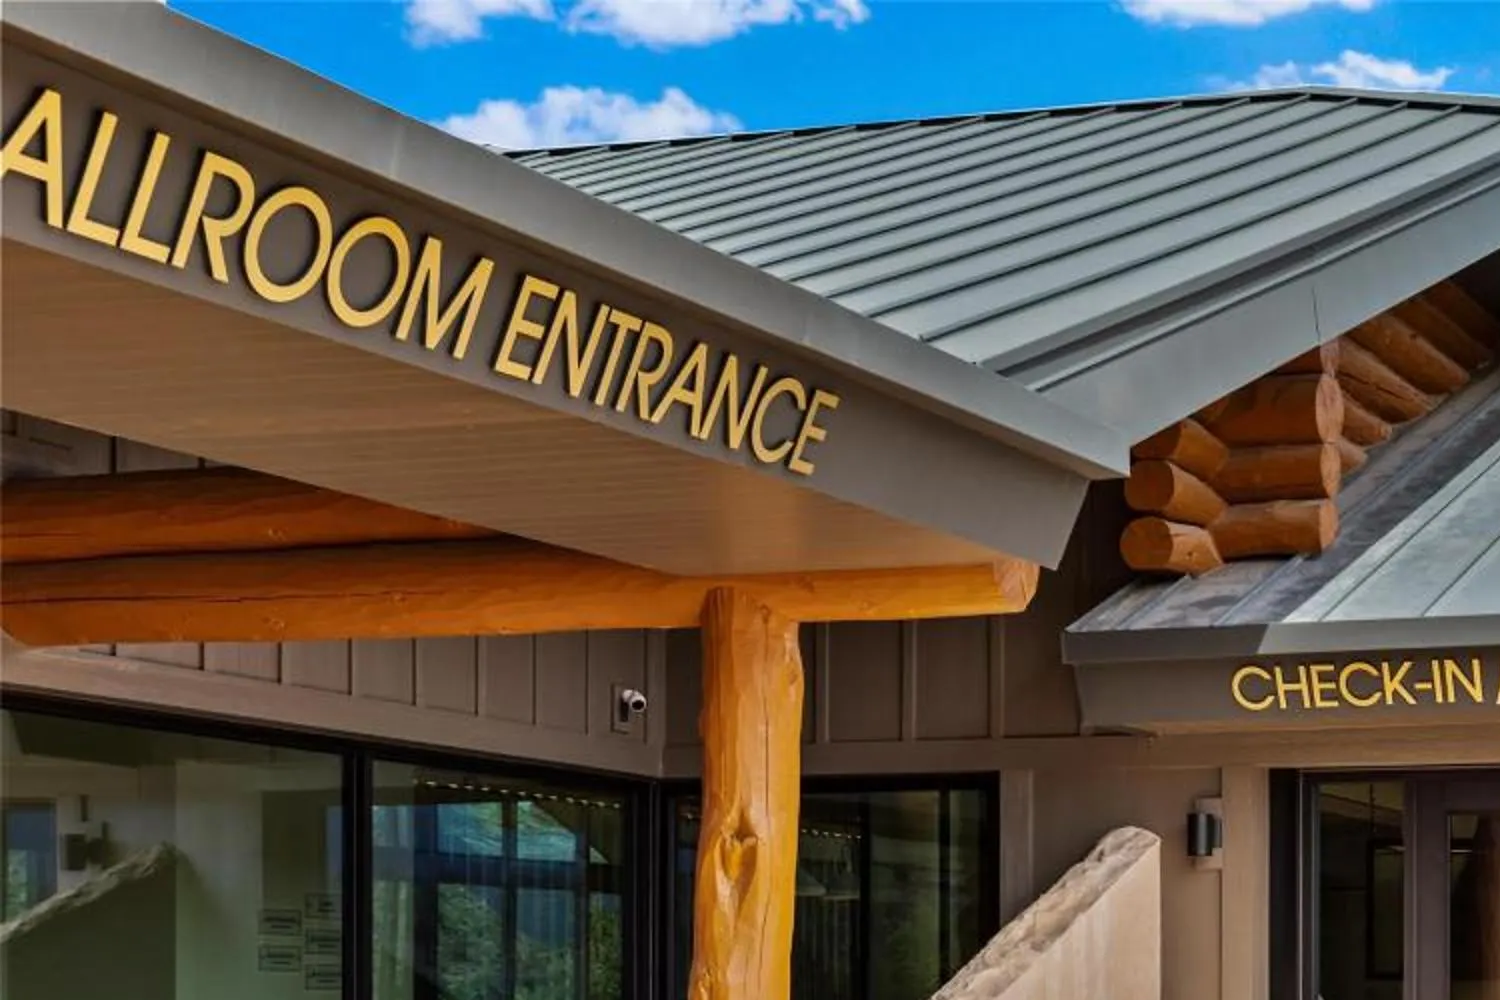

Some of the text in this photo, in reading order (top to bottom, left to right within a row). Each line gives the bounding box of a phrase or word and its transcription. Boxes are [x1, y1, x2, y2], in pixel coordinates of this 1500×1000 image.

[0, 89, 841, 475] ALLROOM ENTRANCE
[1231, 659, 1484, 711] CHECK-IN
